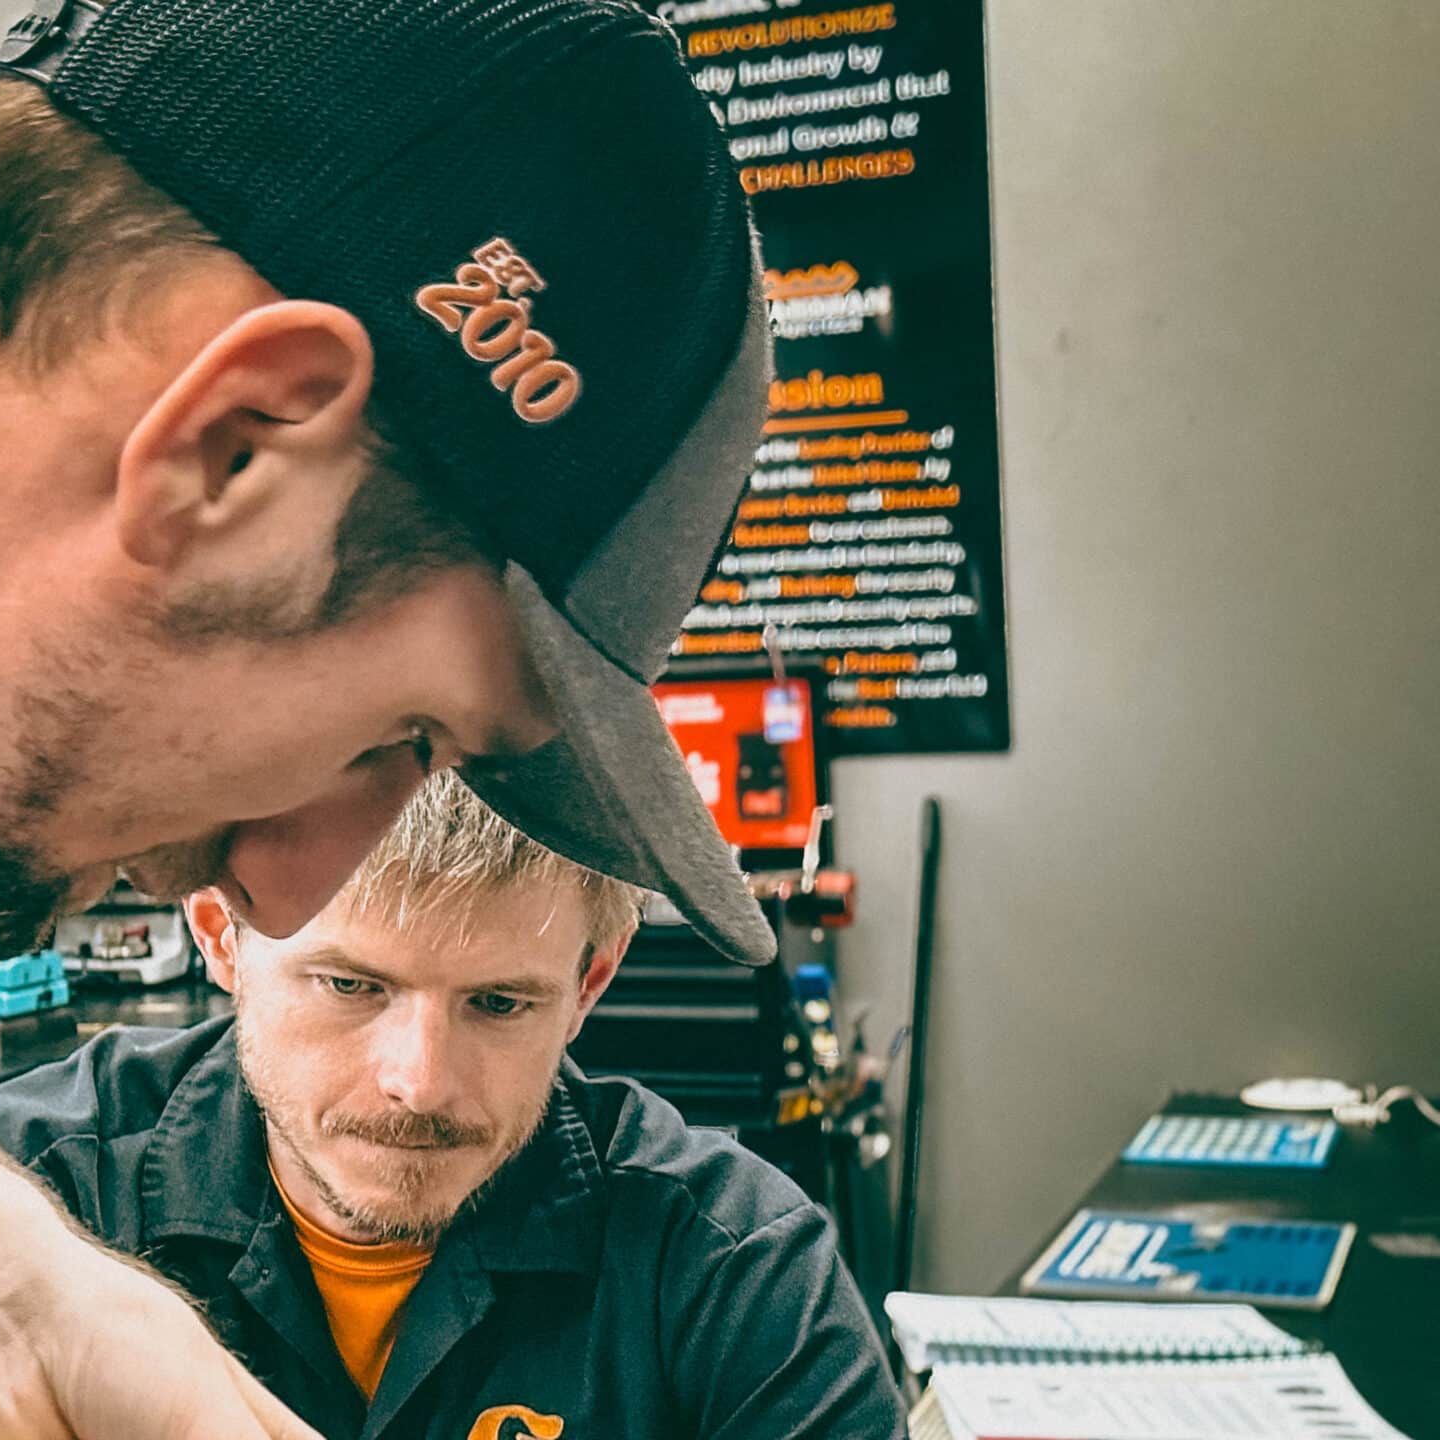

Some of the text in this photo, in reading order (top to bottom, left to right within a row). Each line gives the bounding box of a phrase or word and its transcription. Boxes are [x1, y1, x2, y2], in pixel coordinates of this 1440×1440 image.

[688, 4, 896, 57] REVOLUTIONIZE
[739, 52, 845, 87] Industry
[848, 44, 883, 74] by
[728, 70, 950, 125] Environment that
[792, 116, 888, 151] Growth
[739, 149, 915, 195] CHALLENGES
[415, 262, 579, 423] 2010
